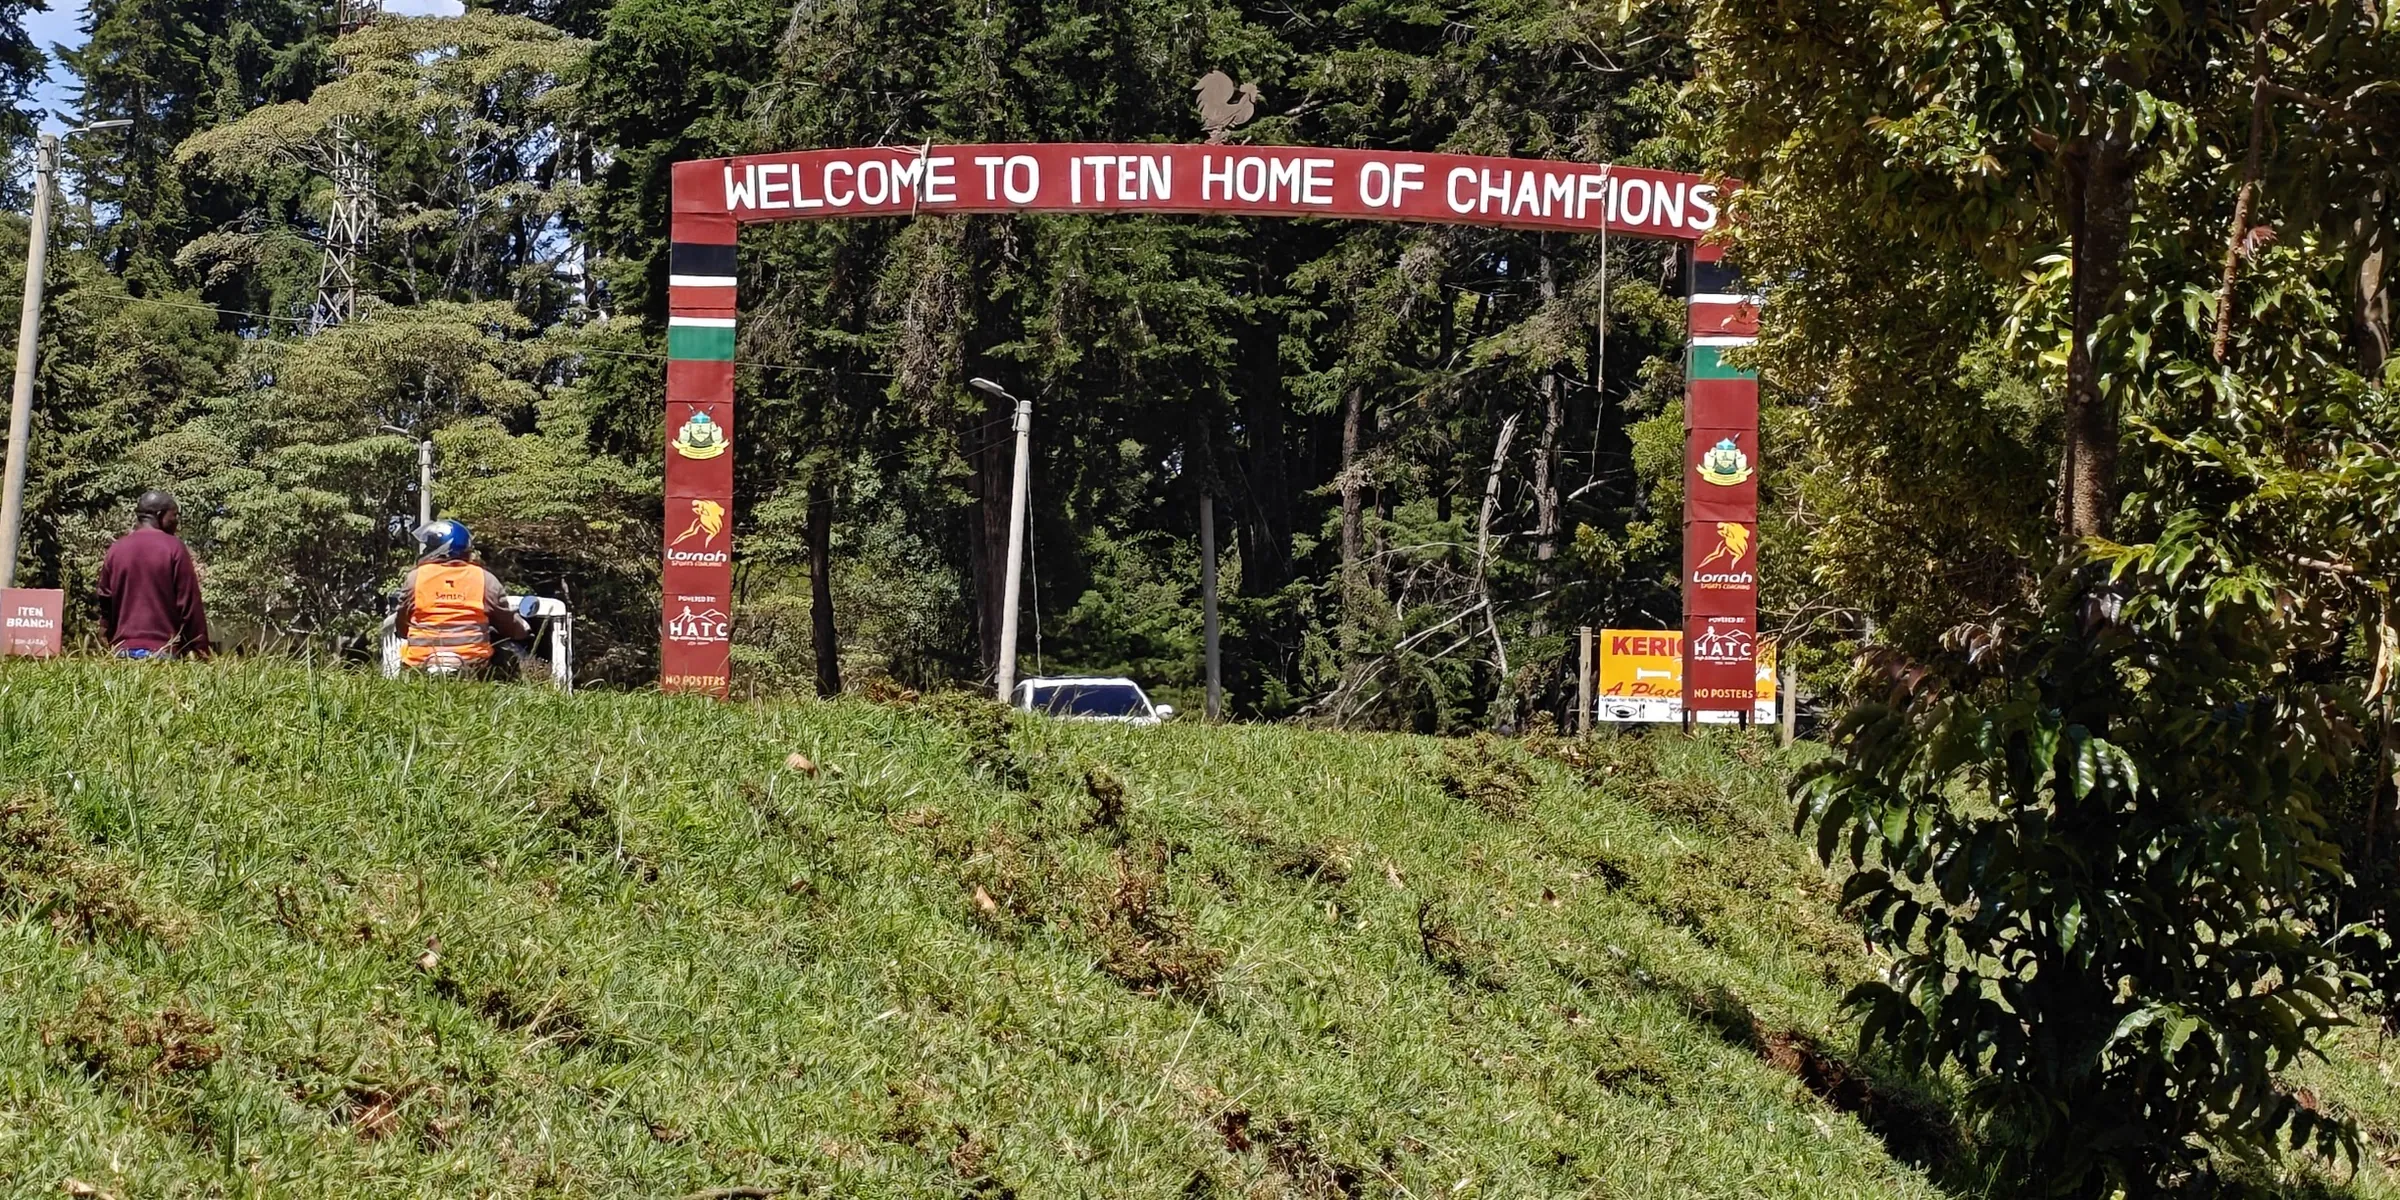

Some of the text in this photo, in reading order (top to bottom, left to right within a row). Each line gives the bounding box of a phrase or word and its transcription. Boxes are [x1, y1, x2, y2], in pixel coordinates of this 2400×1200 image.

[723, 154, 1718, 230] WELCOME TO ITEN HOME OF CHAMPIONS
[667, 548, 727, 562] Lornah
[1693, 570, 1753, 583] Lornah
[18, 606, 44, 617] ITEN
[6, 617, 54, 629] BRANCH
[669, 622, 728, 637] HATC
[1694, 641, 1752, 656] HATC
[665, 675, 726, 686] NO POSTERS
[1604, 682, 1624, 697] A
[1694, 688, 1709, 698] NO
[1711, 689, 1754, 699] POSTERS
